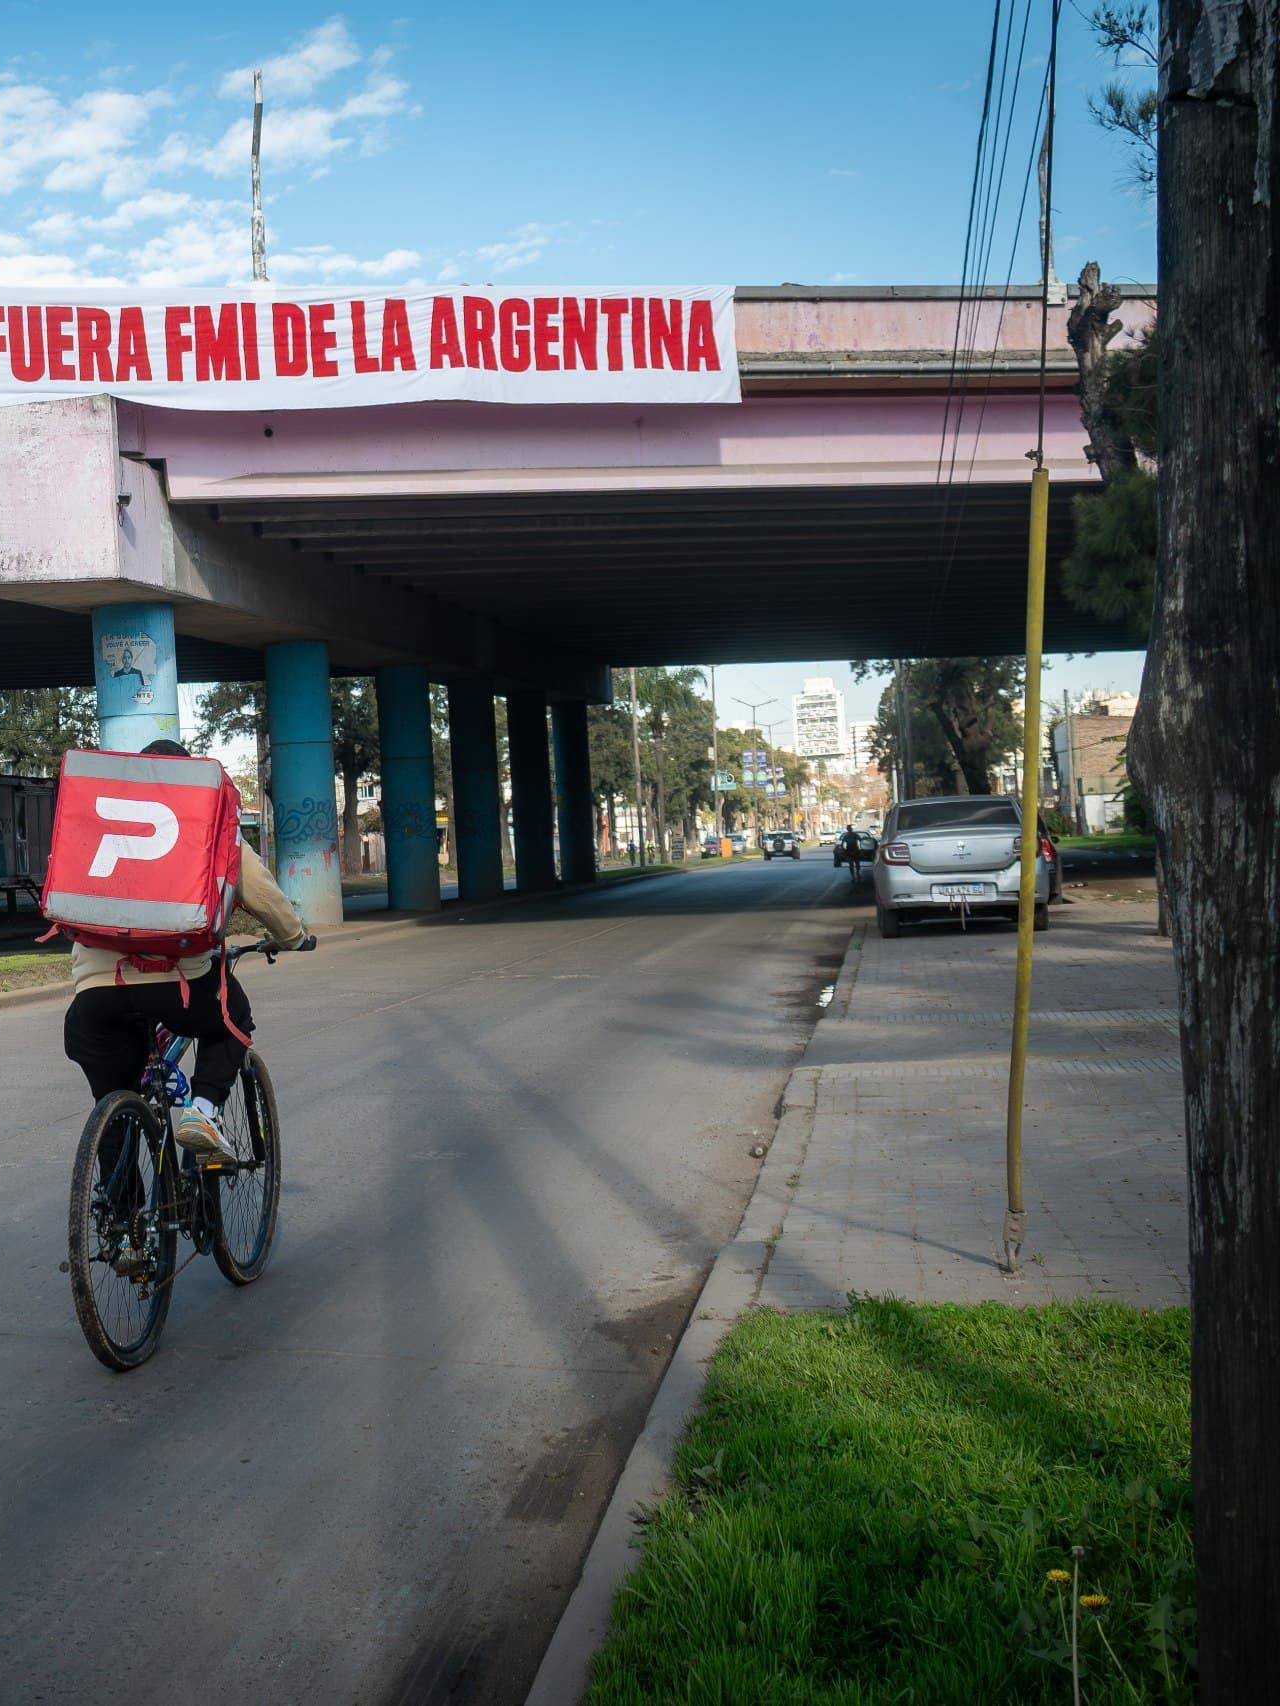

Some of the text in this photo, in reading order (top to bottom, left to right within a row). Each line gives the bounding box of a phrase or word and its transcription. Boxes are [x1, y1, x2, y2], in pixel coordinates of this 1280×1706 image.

[164, 302, 261, 382] FMI
[272, 302, 339, 378] DE
[350, 298, 417, 374] LA
[429, 295, 721, 372] ARGENTINA
